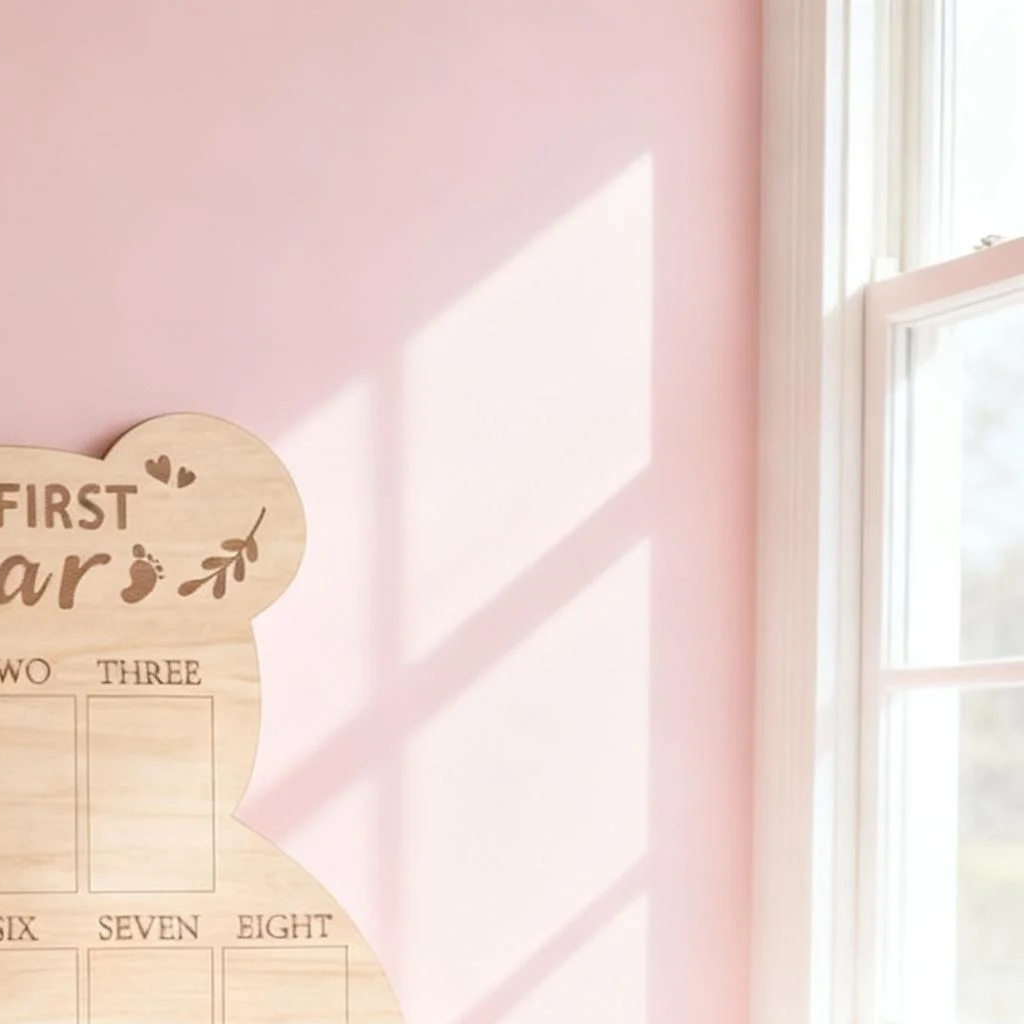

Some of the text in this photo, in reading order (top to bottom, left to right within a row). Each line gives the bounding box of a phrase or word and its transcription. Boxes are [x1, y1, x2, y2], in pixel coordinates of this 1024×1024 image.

[96, 659, 202, 686] THREE
[98, 914, 200, 942] SEVEN
[236, 913, 334, 940] EIGHT
